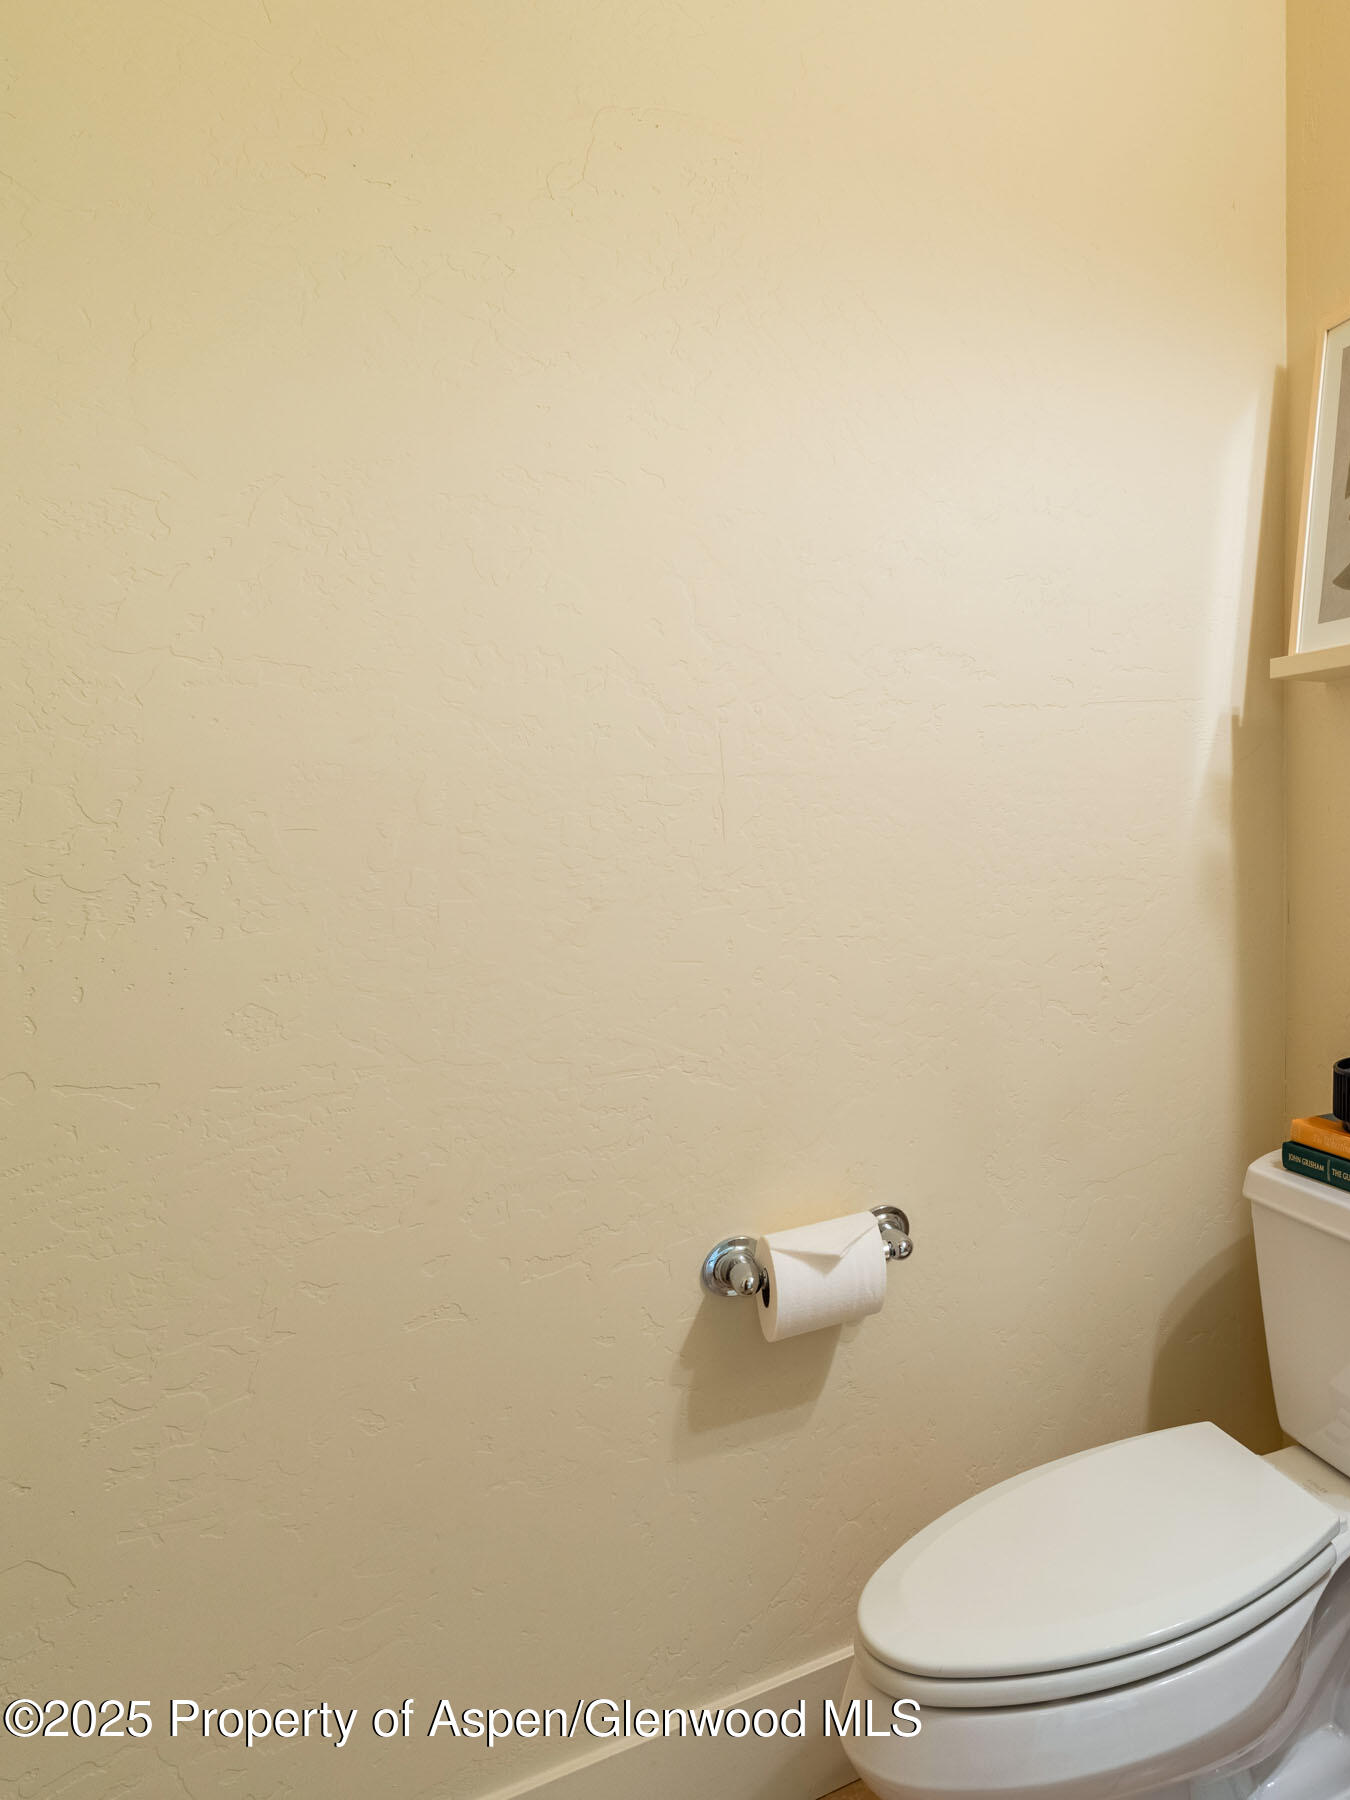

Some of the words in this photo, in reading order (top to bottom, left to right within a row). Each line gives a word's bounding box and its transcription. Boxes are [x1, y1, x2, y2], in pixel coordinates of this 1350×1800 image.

[1288, 1153, 1301, 1163] JOHN
[1302, 1159, 1324, 1171] GRISHAM
[1331, 1168, 1342, 1178] THE
